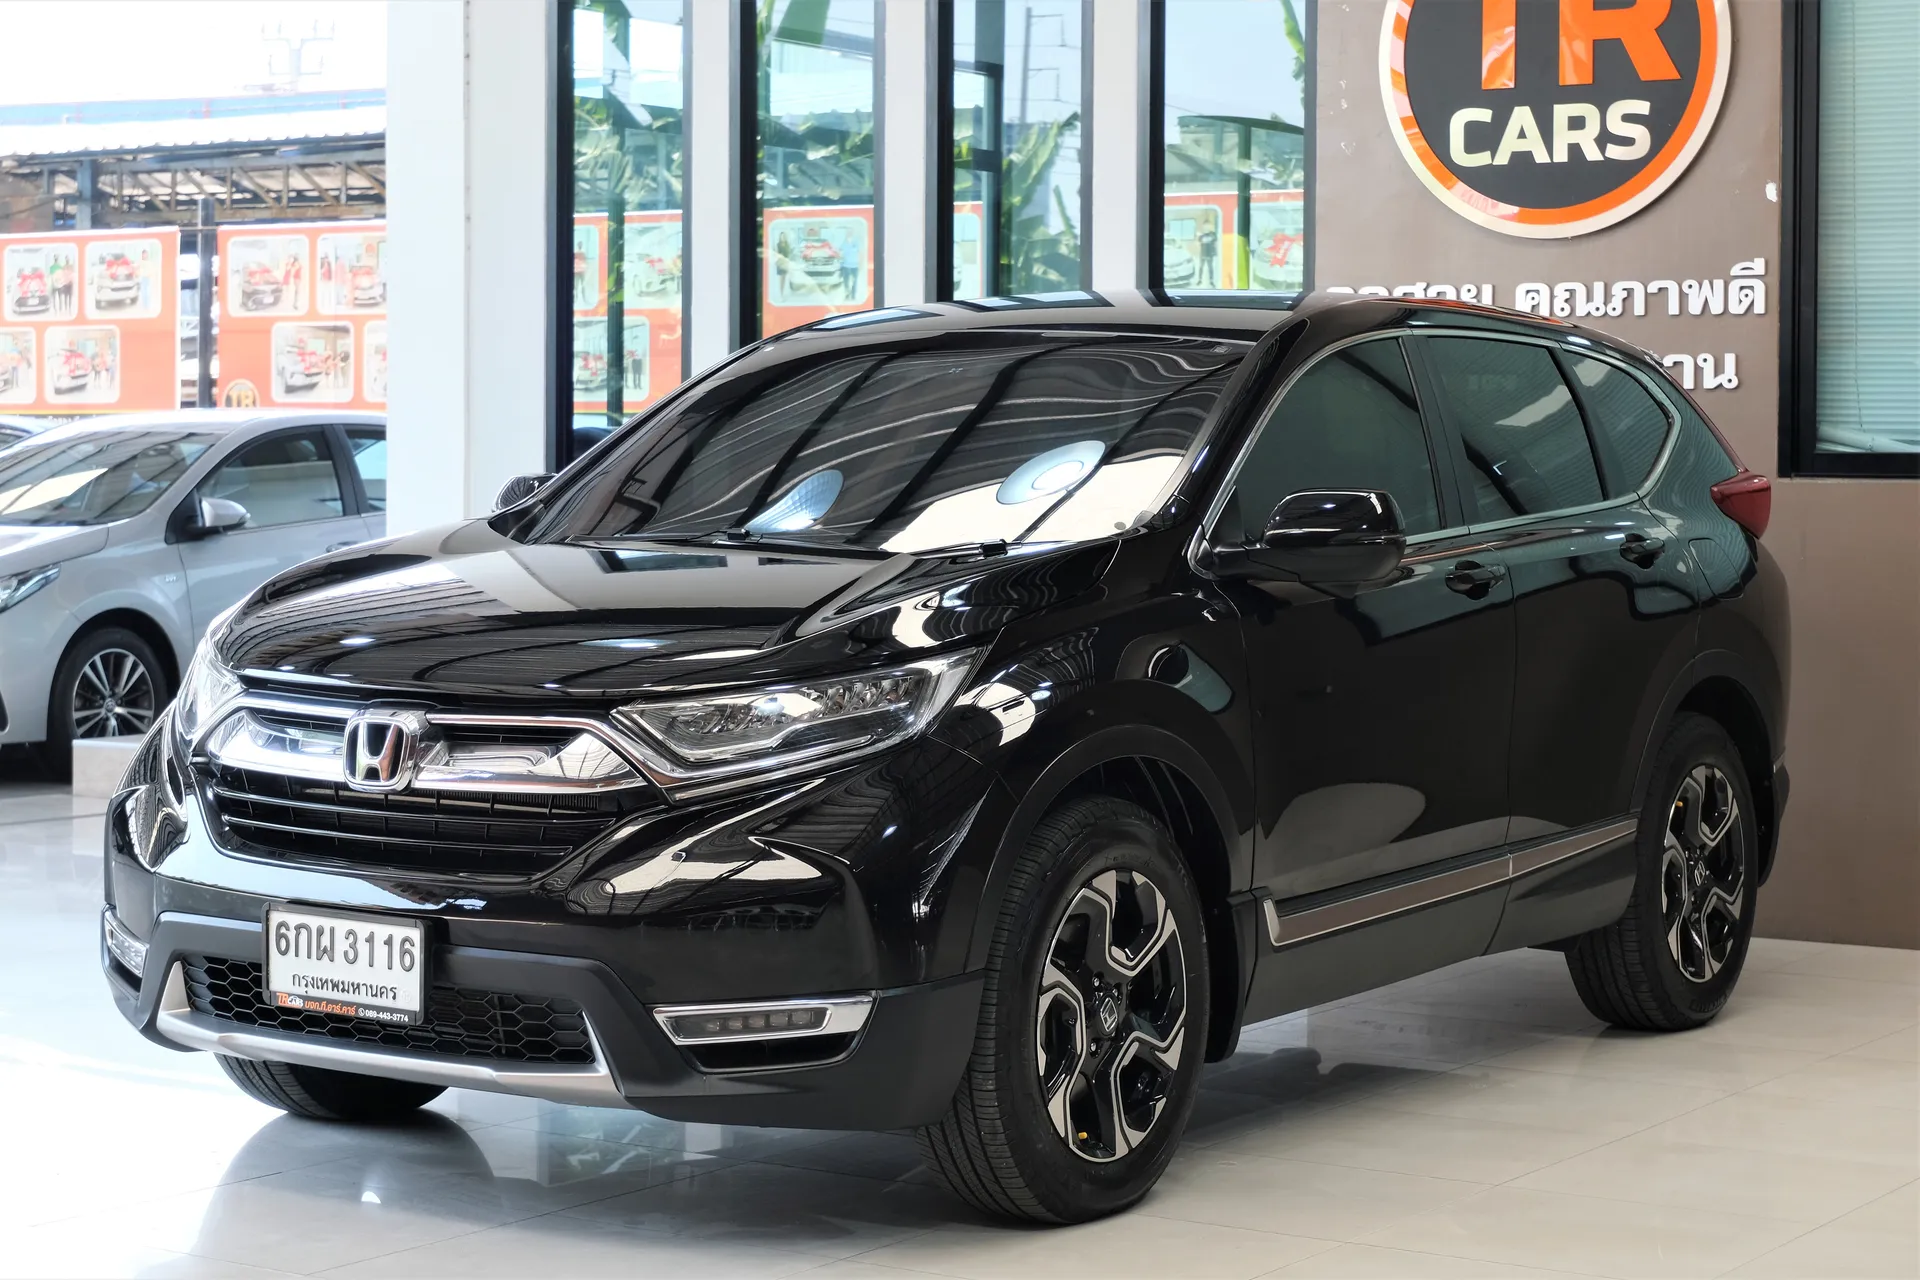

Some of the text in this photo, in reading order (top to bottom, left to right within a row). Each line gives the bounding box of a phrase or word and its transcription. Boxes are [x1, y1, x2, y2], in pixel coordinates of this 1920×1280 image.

[1450, 99, 1652, 168] CARS
[1515, 257, 1767, 318] คณภาพดี
[275, 920, 416, 973] 6กผ 3116
[292, 973, 398, 1001] กรุงเทพมหานคร
[365, 1009, 409, 1023] 089-443-3774
